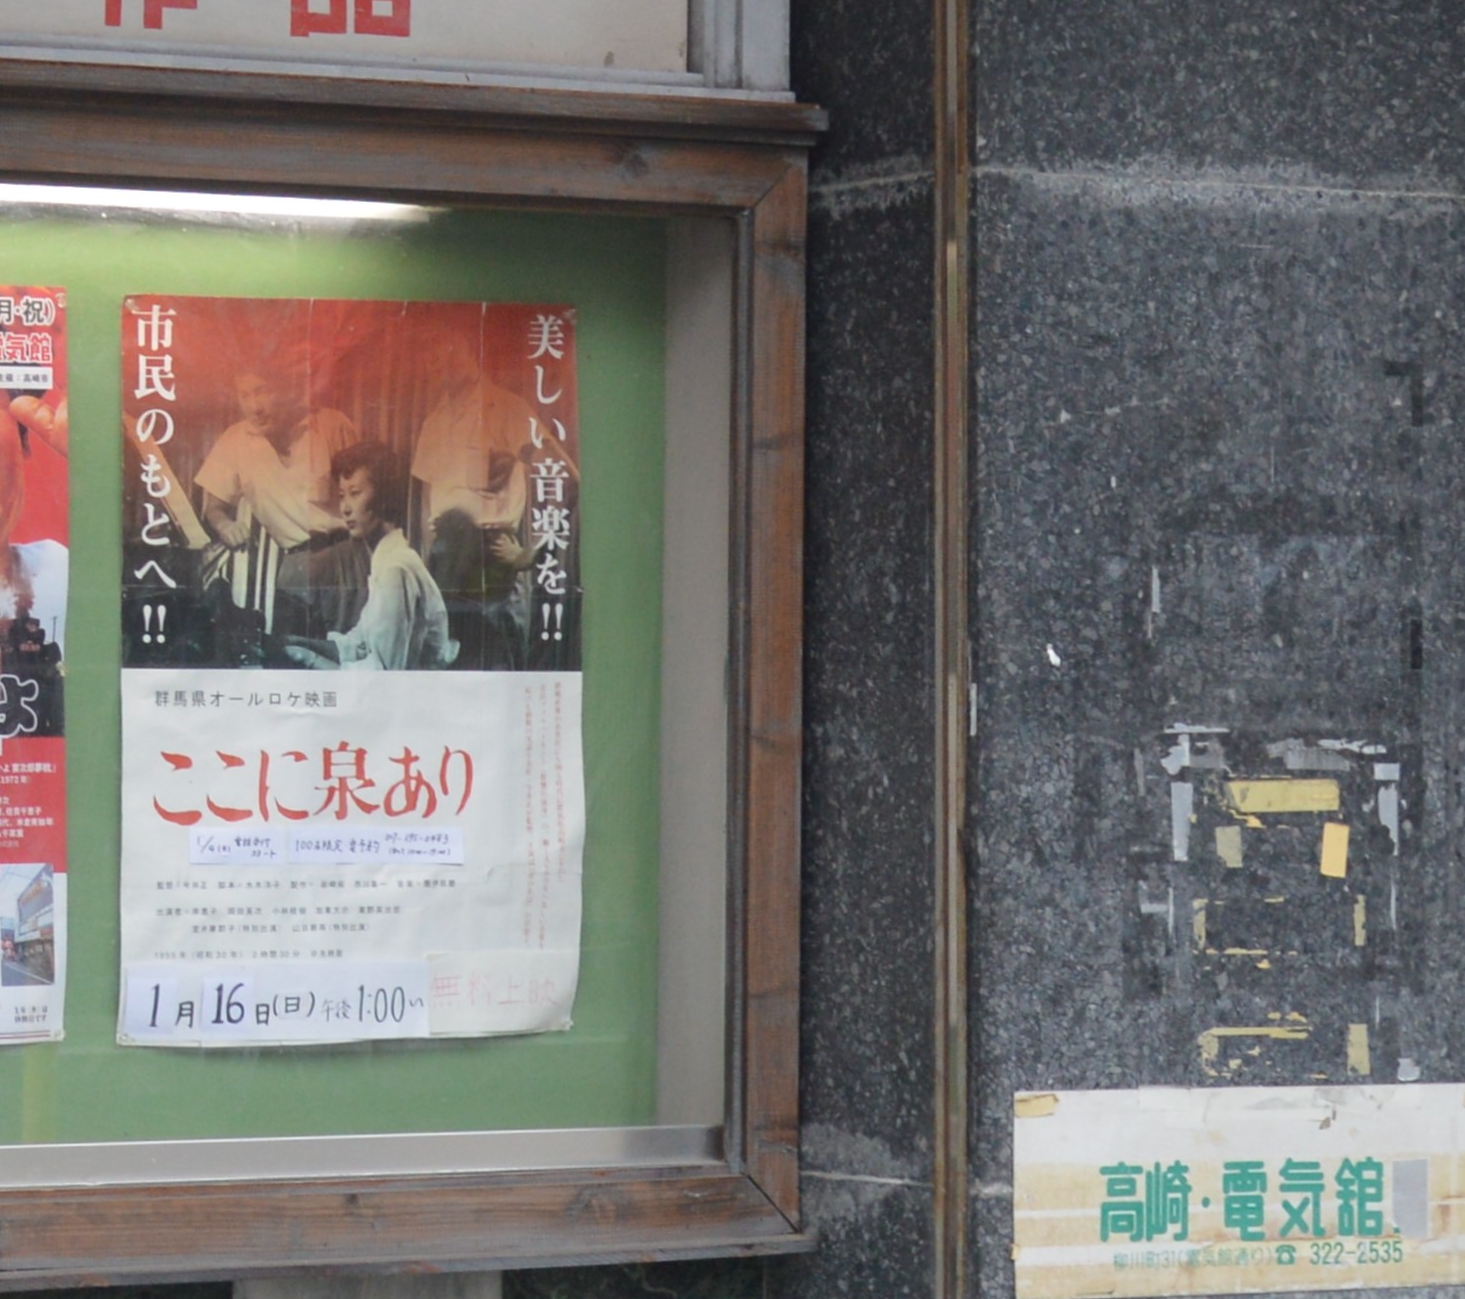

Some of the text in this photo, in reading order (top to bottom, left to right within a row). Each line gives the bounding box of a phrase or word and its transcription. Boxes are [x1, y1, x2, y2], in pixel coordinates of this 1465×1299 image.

[155, 689, 338, 708] 群馬県オールロケ映画
[153, 740, 475, 826] ここに泉あり
[1309, 1241, 1404, 1266] 322-2535
